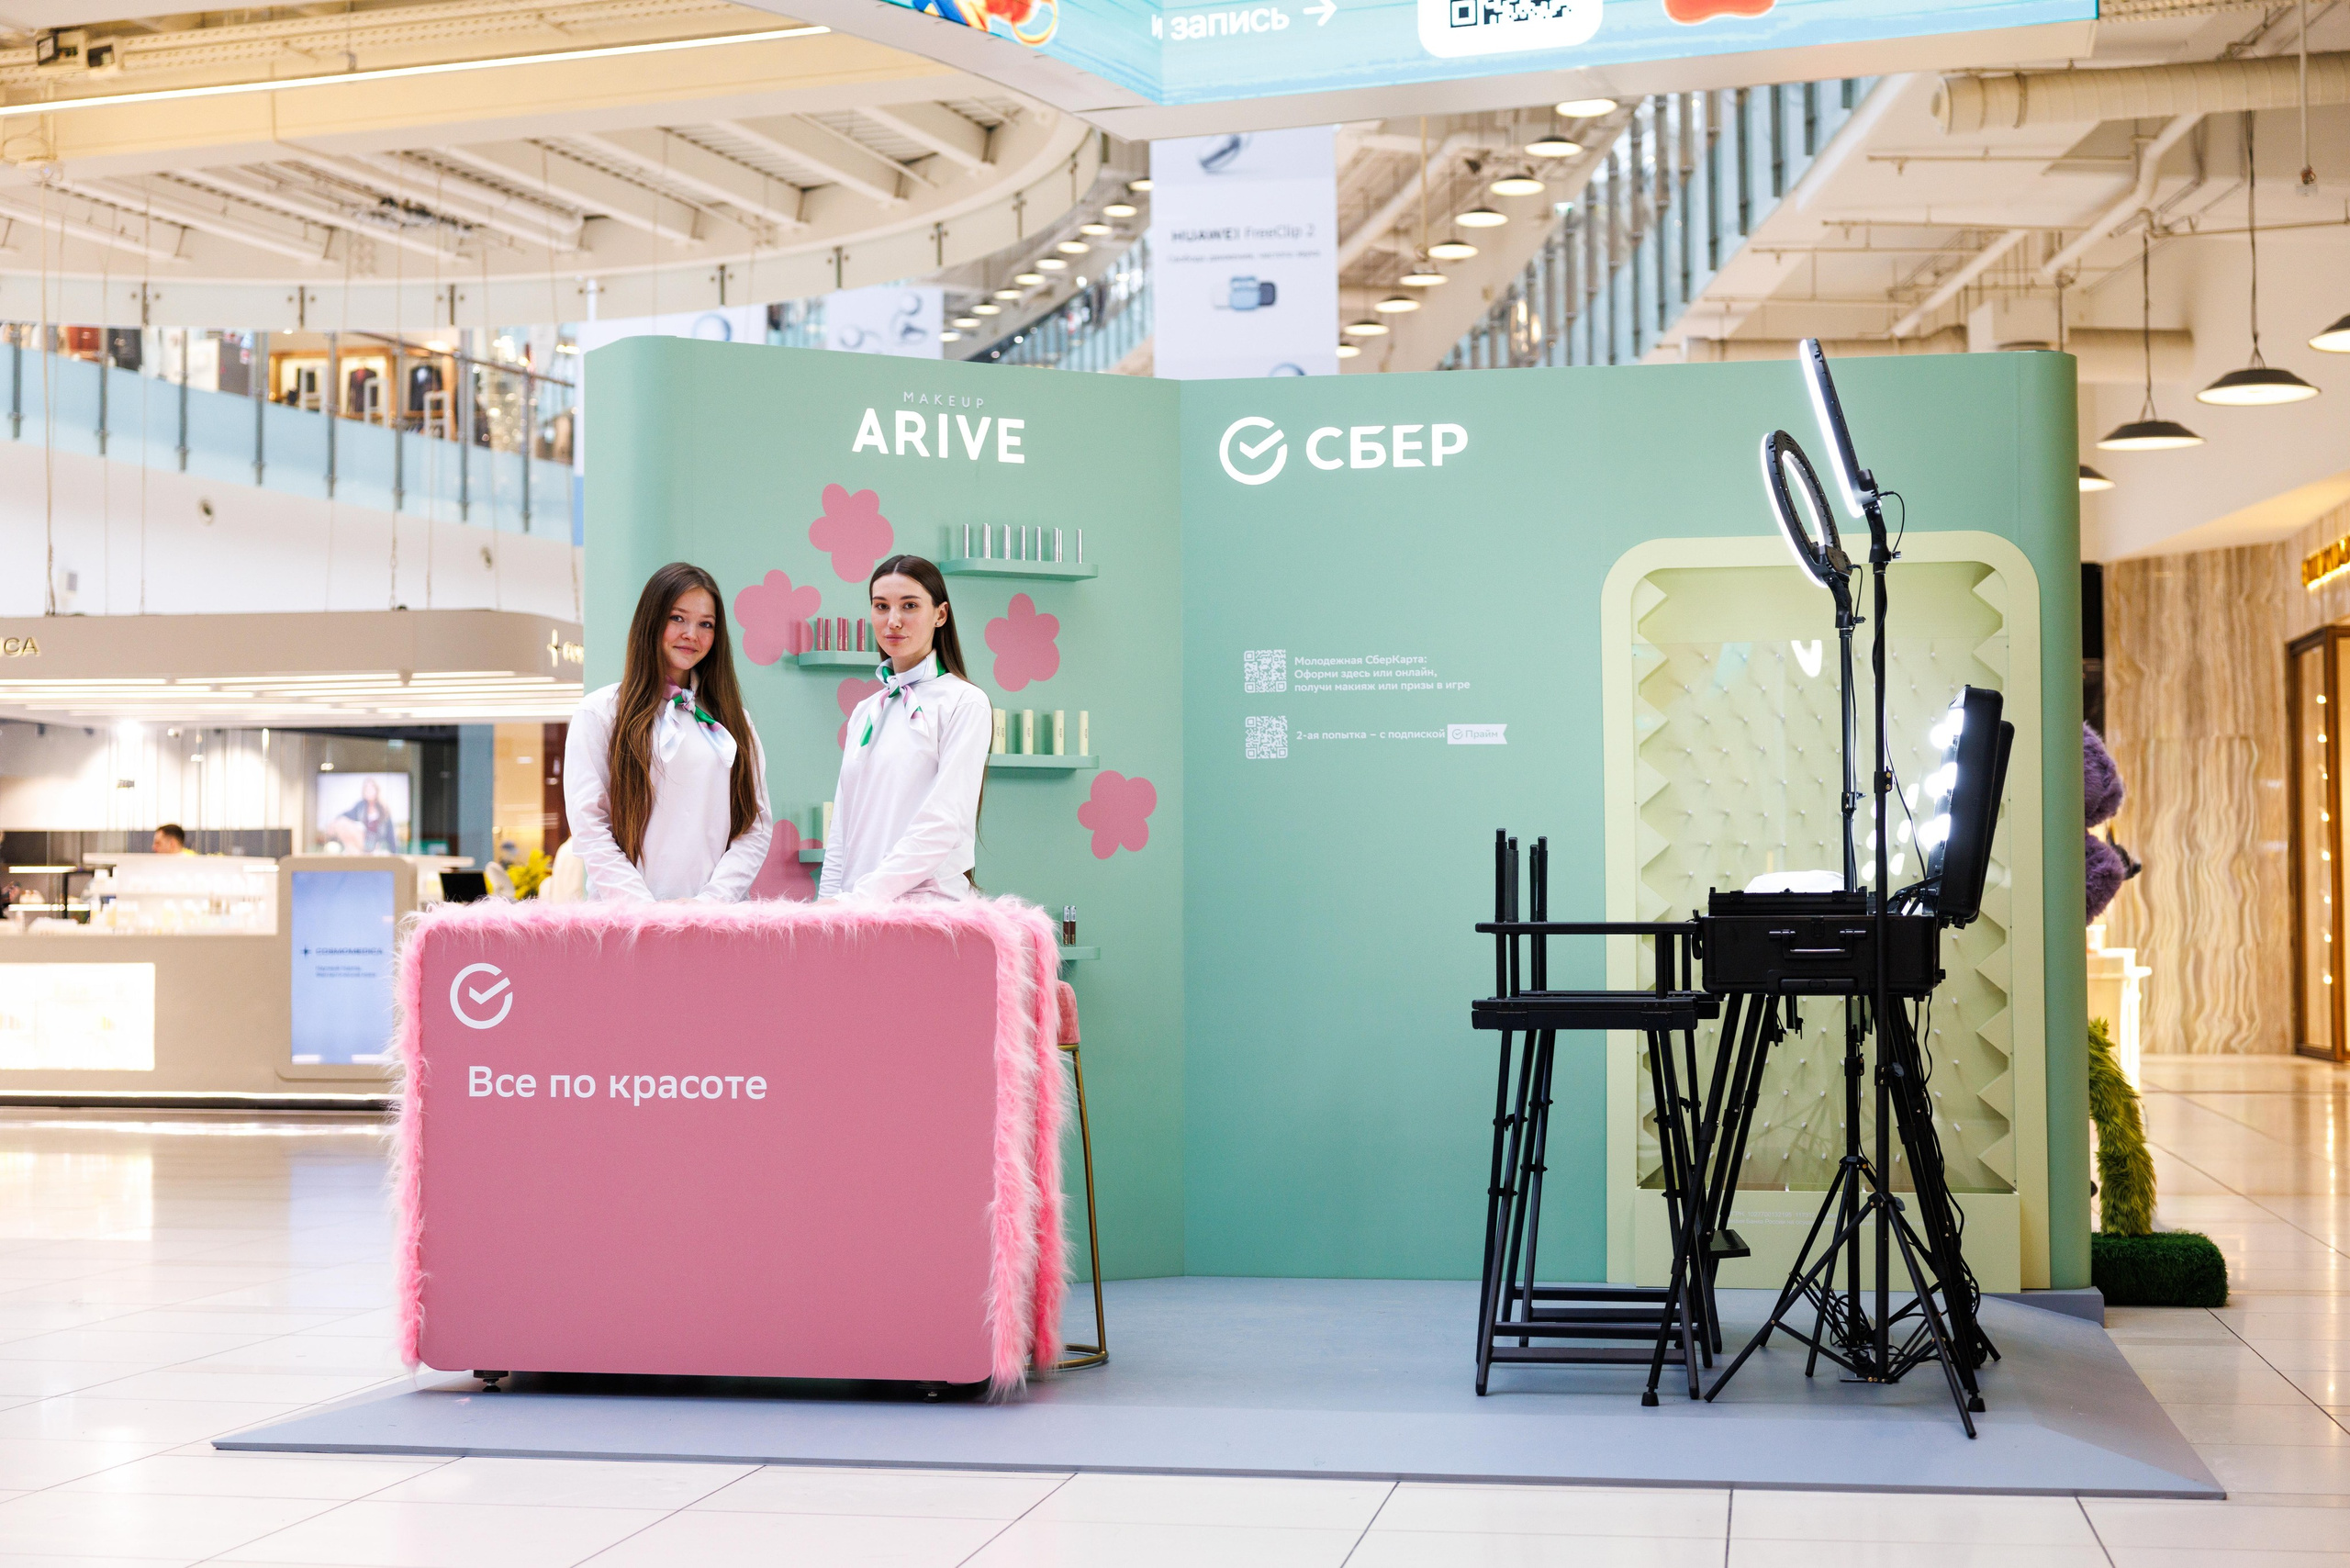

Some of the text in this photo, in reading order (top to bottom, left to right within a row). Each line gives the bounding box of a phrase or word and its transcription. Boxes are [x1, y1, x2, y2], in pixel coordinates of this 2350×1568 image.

[1170, 7, 1290, 40] запись
[903, 391, 984, 409] MAKEUP
[852, 408, 1024, 464] ARIVE
[1305, 423, 1469, 471] СБЕР
[1294, 655, 1427, 666] Молодежная СберКарта:
[1294, 669, 1338, 680] Оформи
[1341, 670, 1371, 678] здесь
[1395, 666, 1438, 678] онлайн,
[1294, 684, 1332, 693] получи
[1335, 683, 1376, 691] макияж
[1401, 682, 1434, 691] призы
[1446, 681, 1471, 690] игре
[1296, 731, 1319, 740] 2-ая
[1322, 732, 1367, 740] попытка
[1388, 729, 1446, 740] подпиской
[1465, 730, 1498, 739] Прайм
[468, 1066, 767, 1106] Все по красоте
